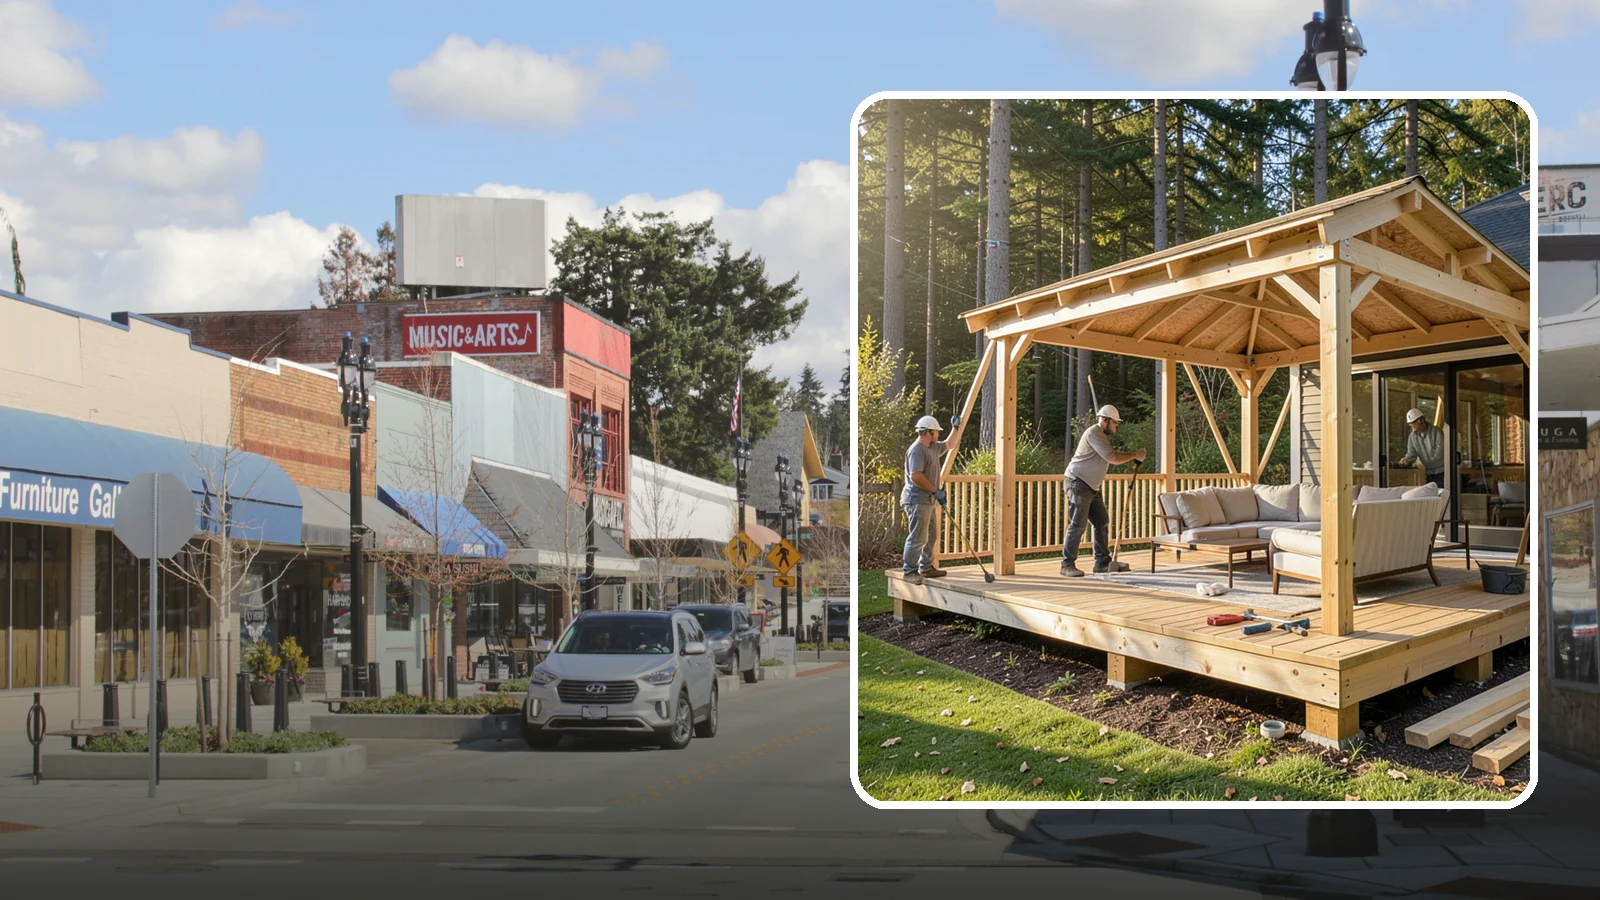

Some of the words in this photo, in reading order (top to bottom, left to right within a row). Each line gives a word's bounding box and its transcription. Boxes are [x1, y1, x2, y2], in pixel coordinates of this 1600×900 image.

[1540, 427, 1577, 436] UGA
[0, 471, 79, 515] Furniture
[453, 563, 479, 574] SUSHI
